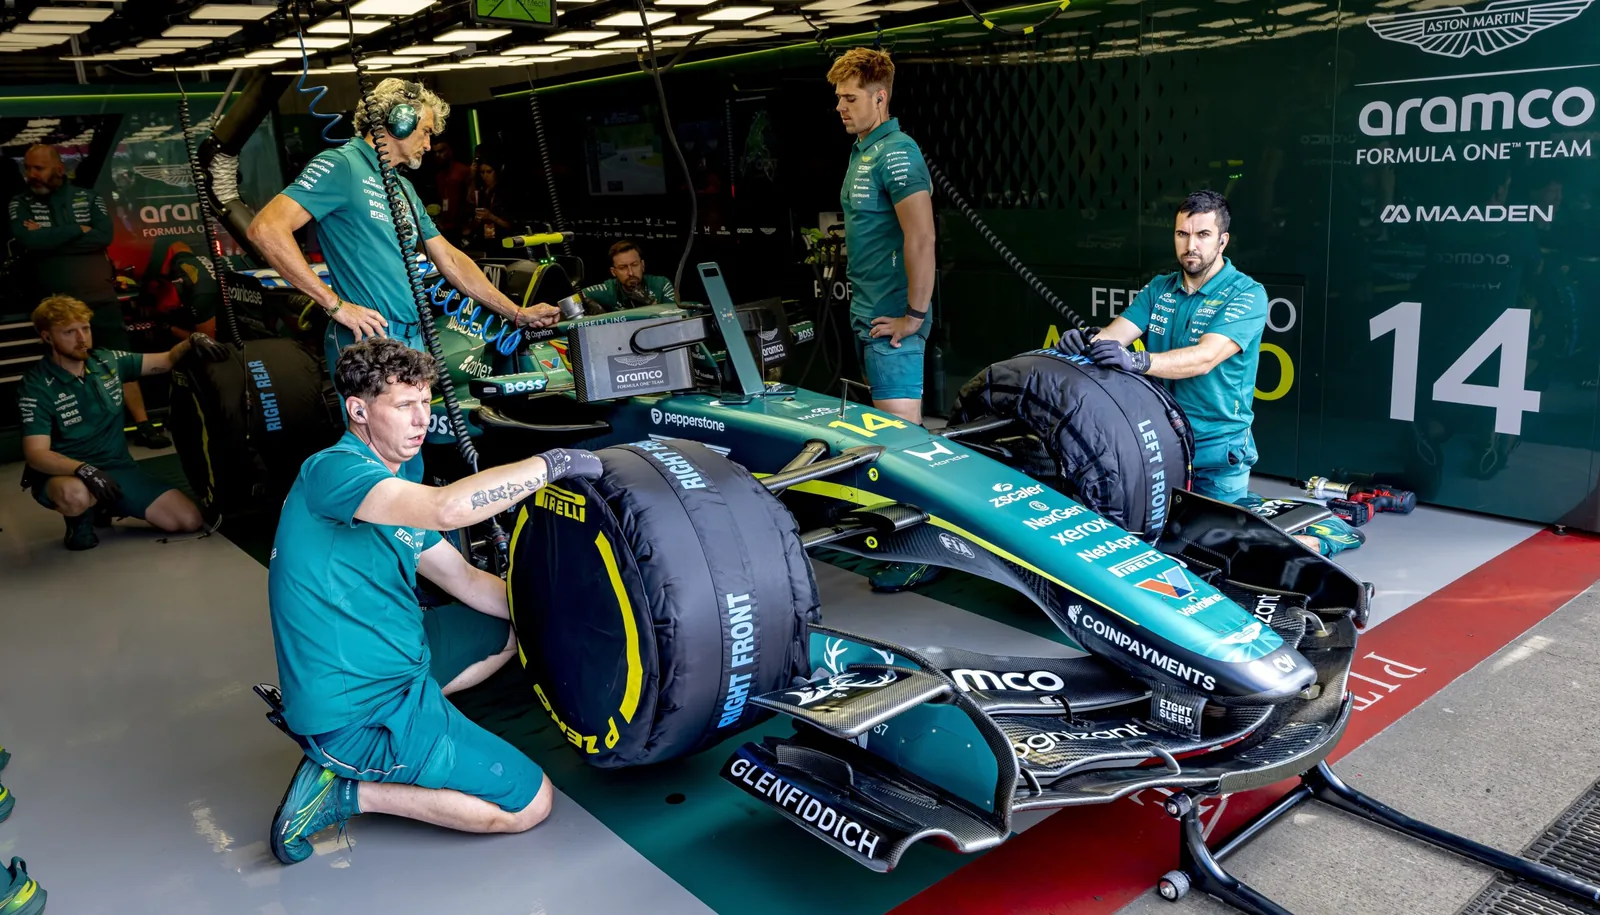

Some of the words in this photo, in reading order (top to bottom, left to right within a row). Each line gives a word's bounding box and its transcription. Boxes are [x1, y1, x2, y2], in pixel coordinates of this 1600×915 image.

[1426, 18, 1469, 33] ASTON
[1472, 11, 1525, 28] MARTIN
[1358, 86, 1595, 136] aramco
[1356, 146, 1456, 165] FORMULA
[1525, 139, 1592, 159] TEAM
[1415, 204, 1554, 222] MAADEN
[143, 226, 194, 237] FORMULA
[1150, 313, 1169, 324] BOSS
[531, 328, 554, 340] Cognition
[798, 327, 815, 340] BOSS
[762, 343, 784, 356] aramco
[247, 360, 273, 388] REAR
[616, 369, 663, 383] aramco
[1369, 301, 1541, 435] 14
[505, 379, 544, 393] BOSS
[61, 409, 79, 419] BOSS
[259, 392, 283, 432] RIGHT
[664, 412, 725, 432] pepperstone
[828, 412, 908, 438] 14
[1138, 419, 1163, 463] LEFT
[652, 451, 707, 489] RIGHT
[535, 484, 586, 523] PIRELLI
[989, 484, 1045, 508] zscaler
[1151, 470, 1166, 530] FRONT
[1022, 504, 1088, 531] NexGen
[1050, 518, 1114, 546] xerox
[1076, 535, 1141, 563] NetApp
[1107, 549, 1166, 578] PIRELLI
[1176, 593, 1226, 617] Valvoline
[726, 593, 754, 668] FRONT
[1082, 614, 1217, 691] COINPAYMENTS
[717, 673, 752, 729] RIGHT
[1159, 698, 1193, 717] EIGHT
[1159, 708, 1193, 727] SLEEP
[730, 758, 880, 860] GLENFIDDICH
